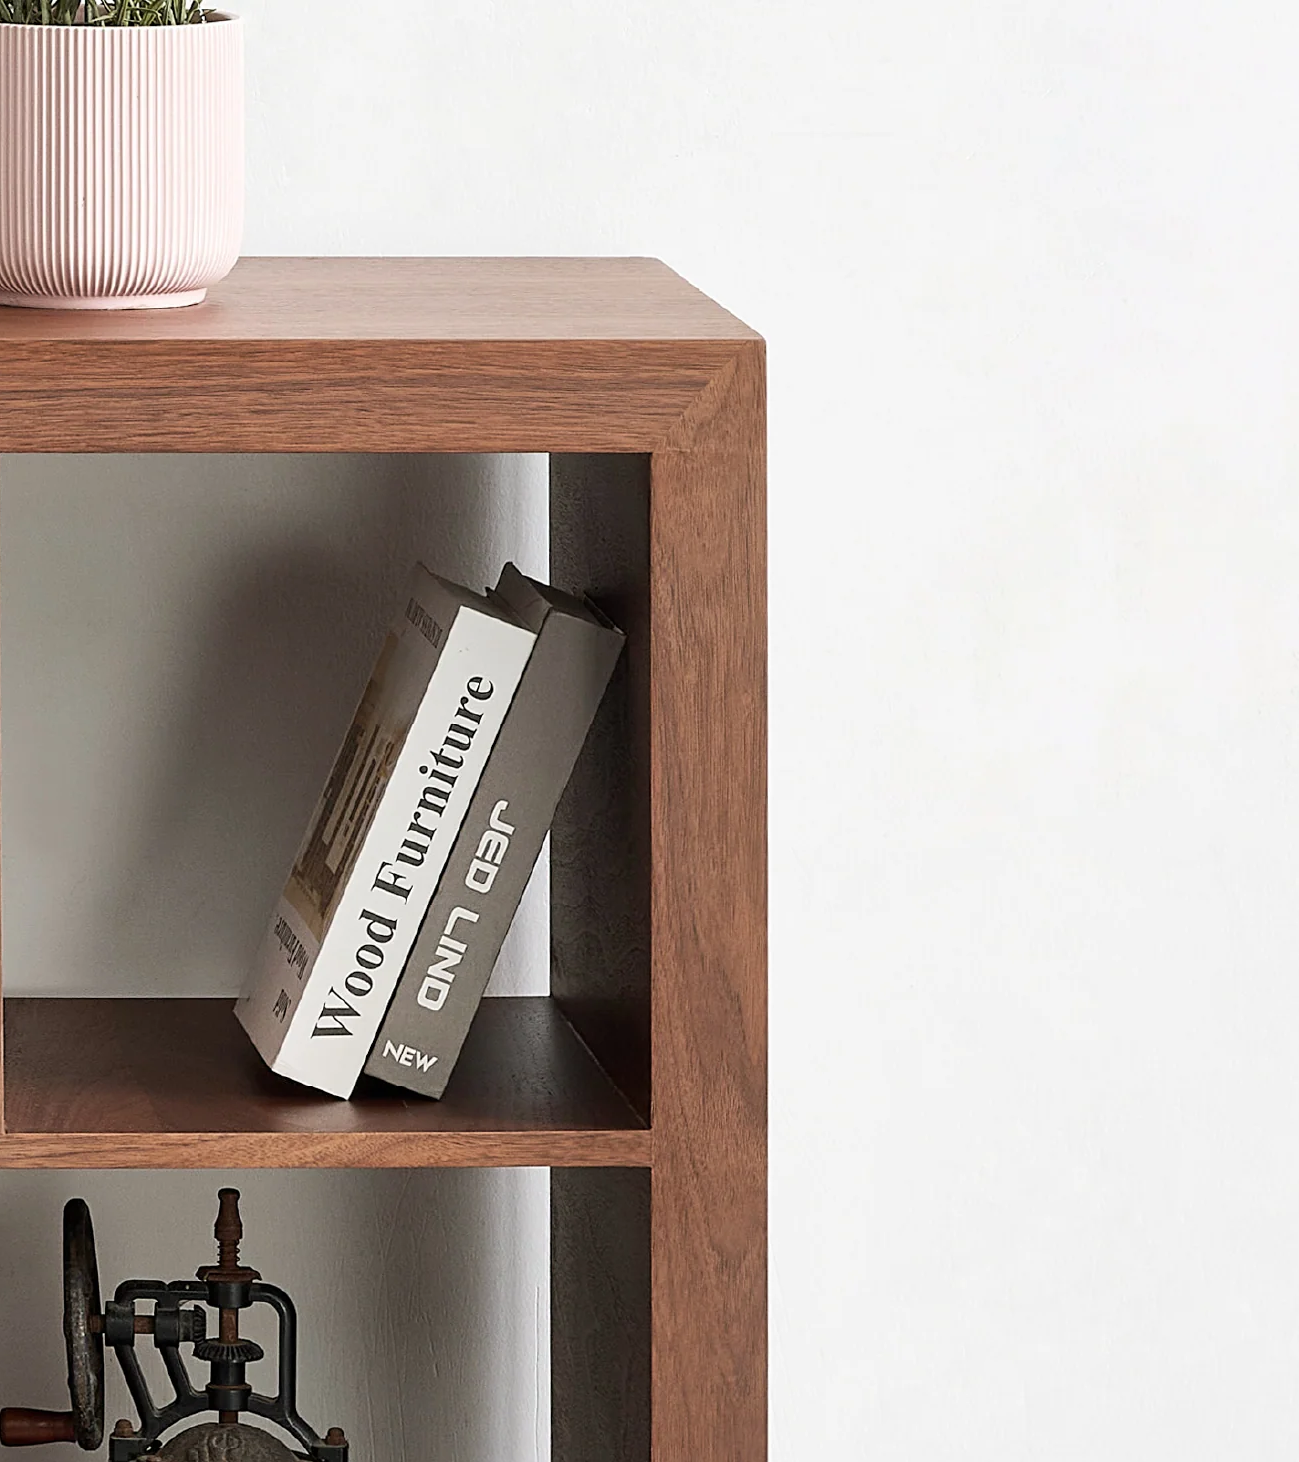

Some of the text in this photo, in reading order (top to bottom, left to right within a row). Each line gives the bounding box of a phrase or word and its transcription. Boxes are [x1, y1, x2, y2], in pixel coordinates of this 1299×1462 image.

[310, 674, 494, 1040] Wood Furniture
[416, 799, 516, 1013] JED LIND
[382, 1039, 438, 1074] NEW
